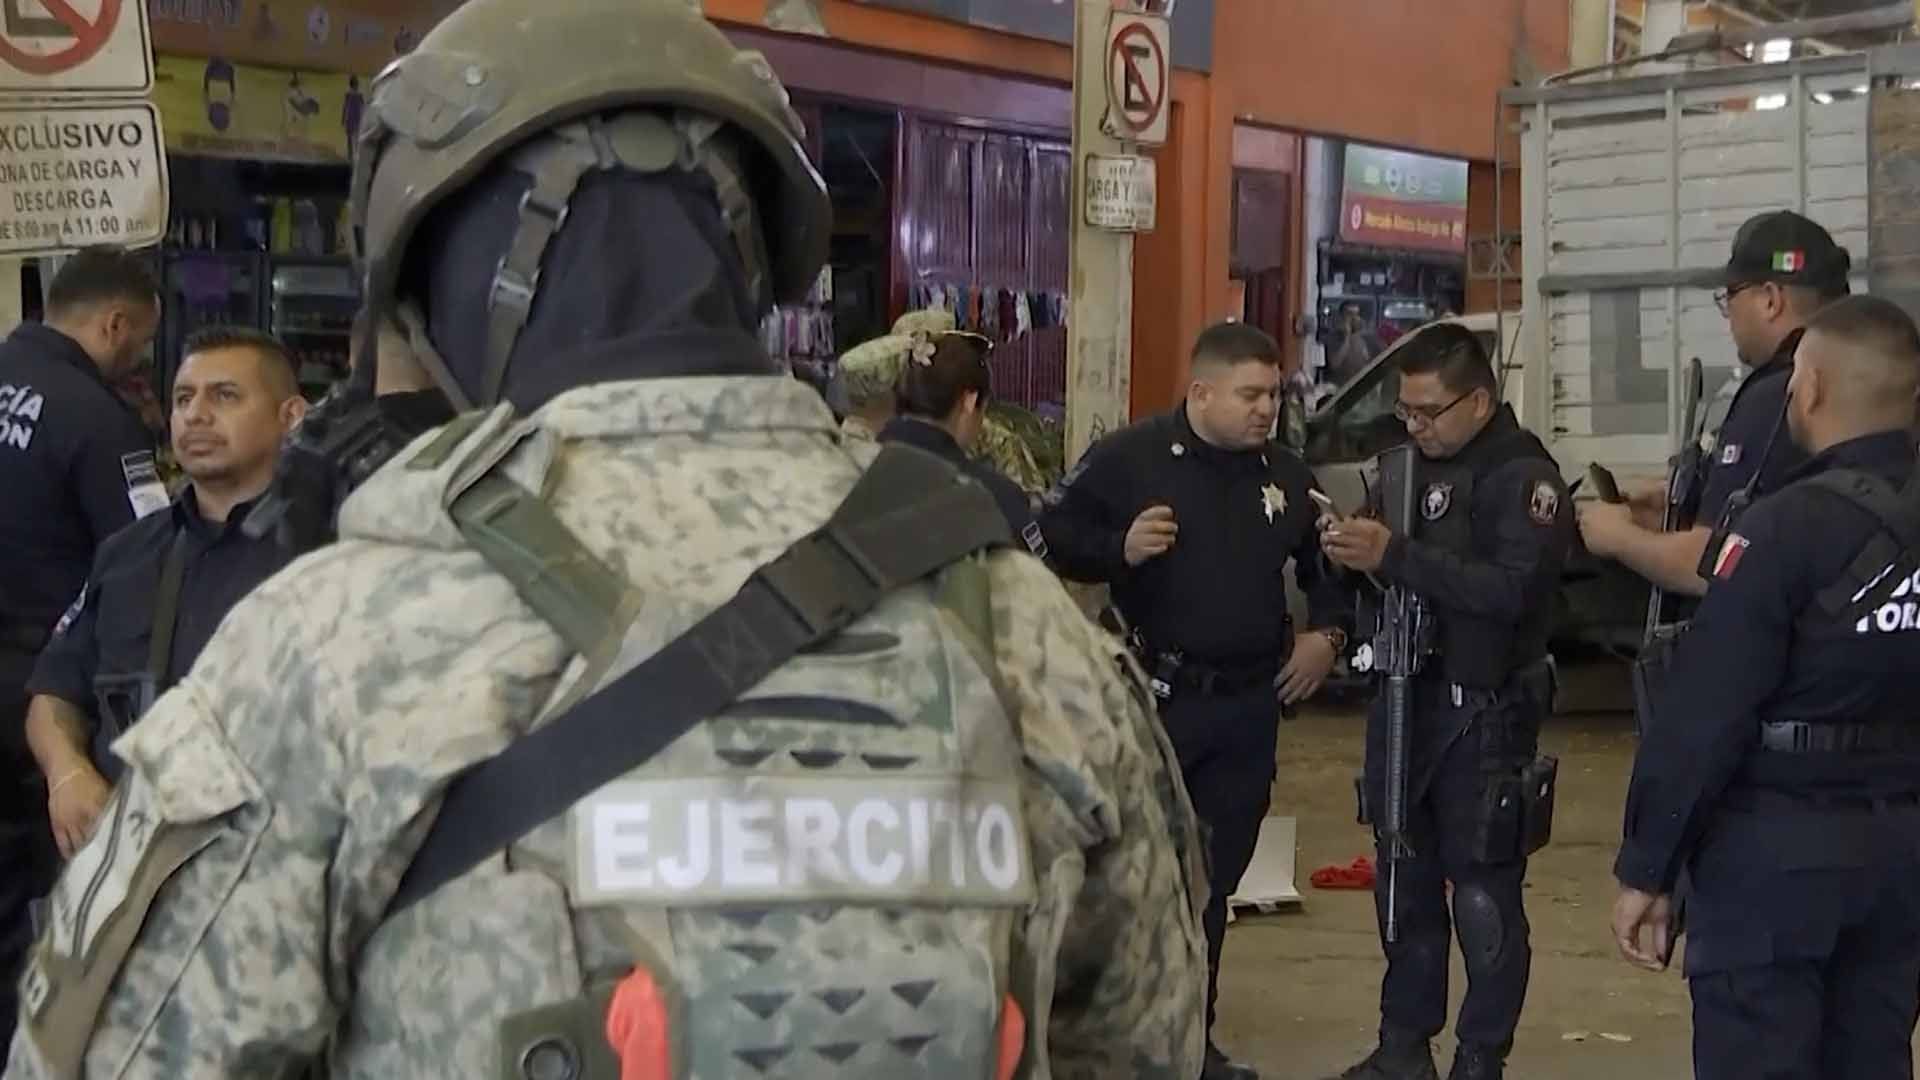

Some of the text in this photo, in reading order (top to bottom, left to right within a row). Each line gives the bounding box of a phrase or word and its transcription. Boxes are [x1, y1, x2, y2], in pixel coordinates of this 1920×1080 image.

[30, 161, 52, 181] DE
[55, 160, 124, 181] CARGA
[128, 159, 141, 177] Y
[14, 189, 113, 212] DESCARGA
[593, 777, 1020, 891] EJÉRCITO
